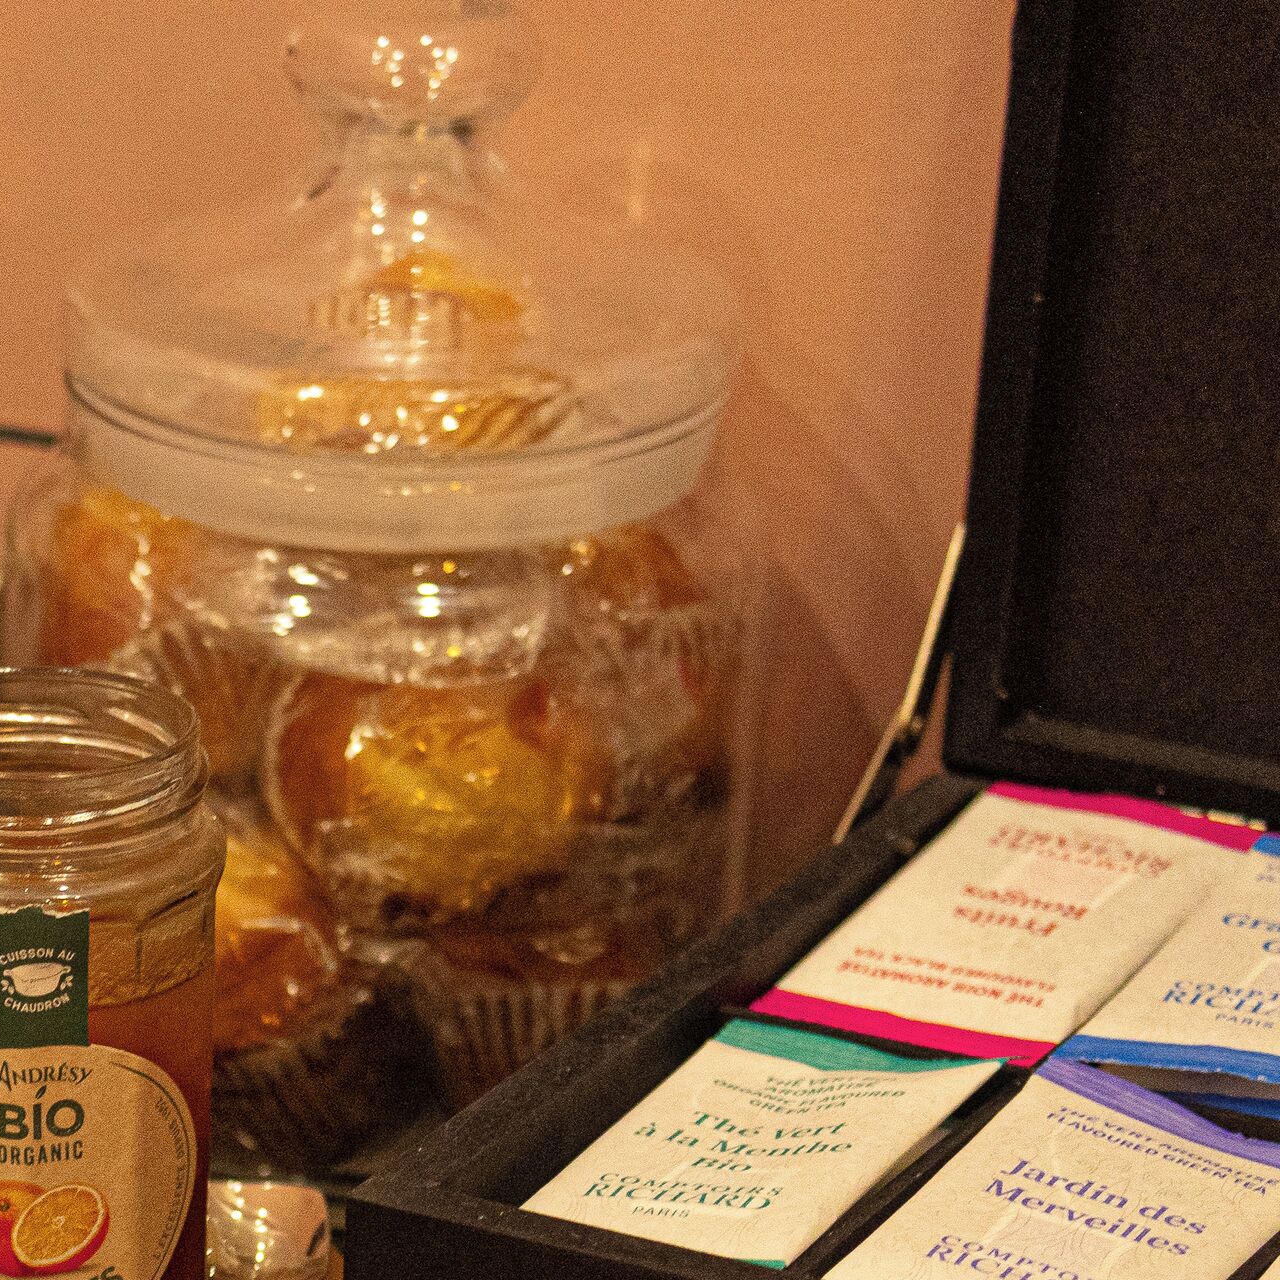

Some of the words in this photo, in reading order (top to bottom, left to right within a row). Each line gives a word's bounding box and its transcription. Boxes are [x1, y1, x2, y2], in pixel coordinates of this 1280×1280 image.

[963, 884, 1088, 921] Rouges
[955, 904, 1059, 936] Fruits
[57, 949, 76, 962] AU
[3, 993, 71, 1013] CHAUDRON
[748, 1099, 811, 1115] GREEN
[816, 1101, 847, 1112] TEA
[798, 1090, 906, 1106] FLAVOURED
[693, 1110, 763, 1137] Thé
[633, 1121, 657, 1138] à
[666, 1126, 700, 1148] la
[709, 1133, 854, 1158] Menthe
[690, 1156, 753, 1173] Bio
[1046, 1111, 1159, 1157] FLAVOURED
[1162, 1153, 1228, 1180] GREEN
[1232, 1177, 1268, 1196] TEA
[582, 1182, 773, 1211] RICHARD
[597, 1171, 784, 1196] COMPTOIRS
[999, 1159, 1129, 1210] Jardin
[1139, 1205, 1208, 1236] des
[631, 1205, 691, 1219] PARIS
[984, 1178, 1192, 1257] Merveilles
